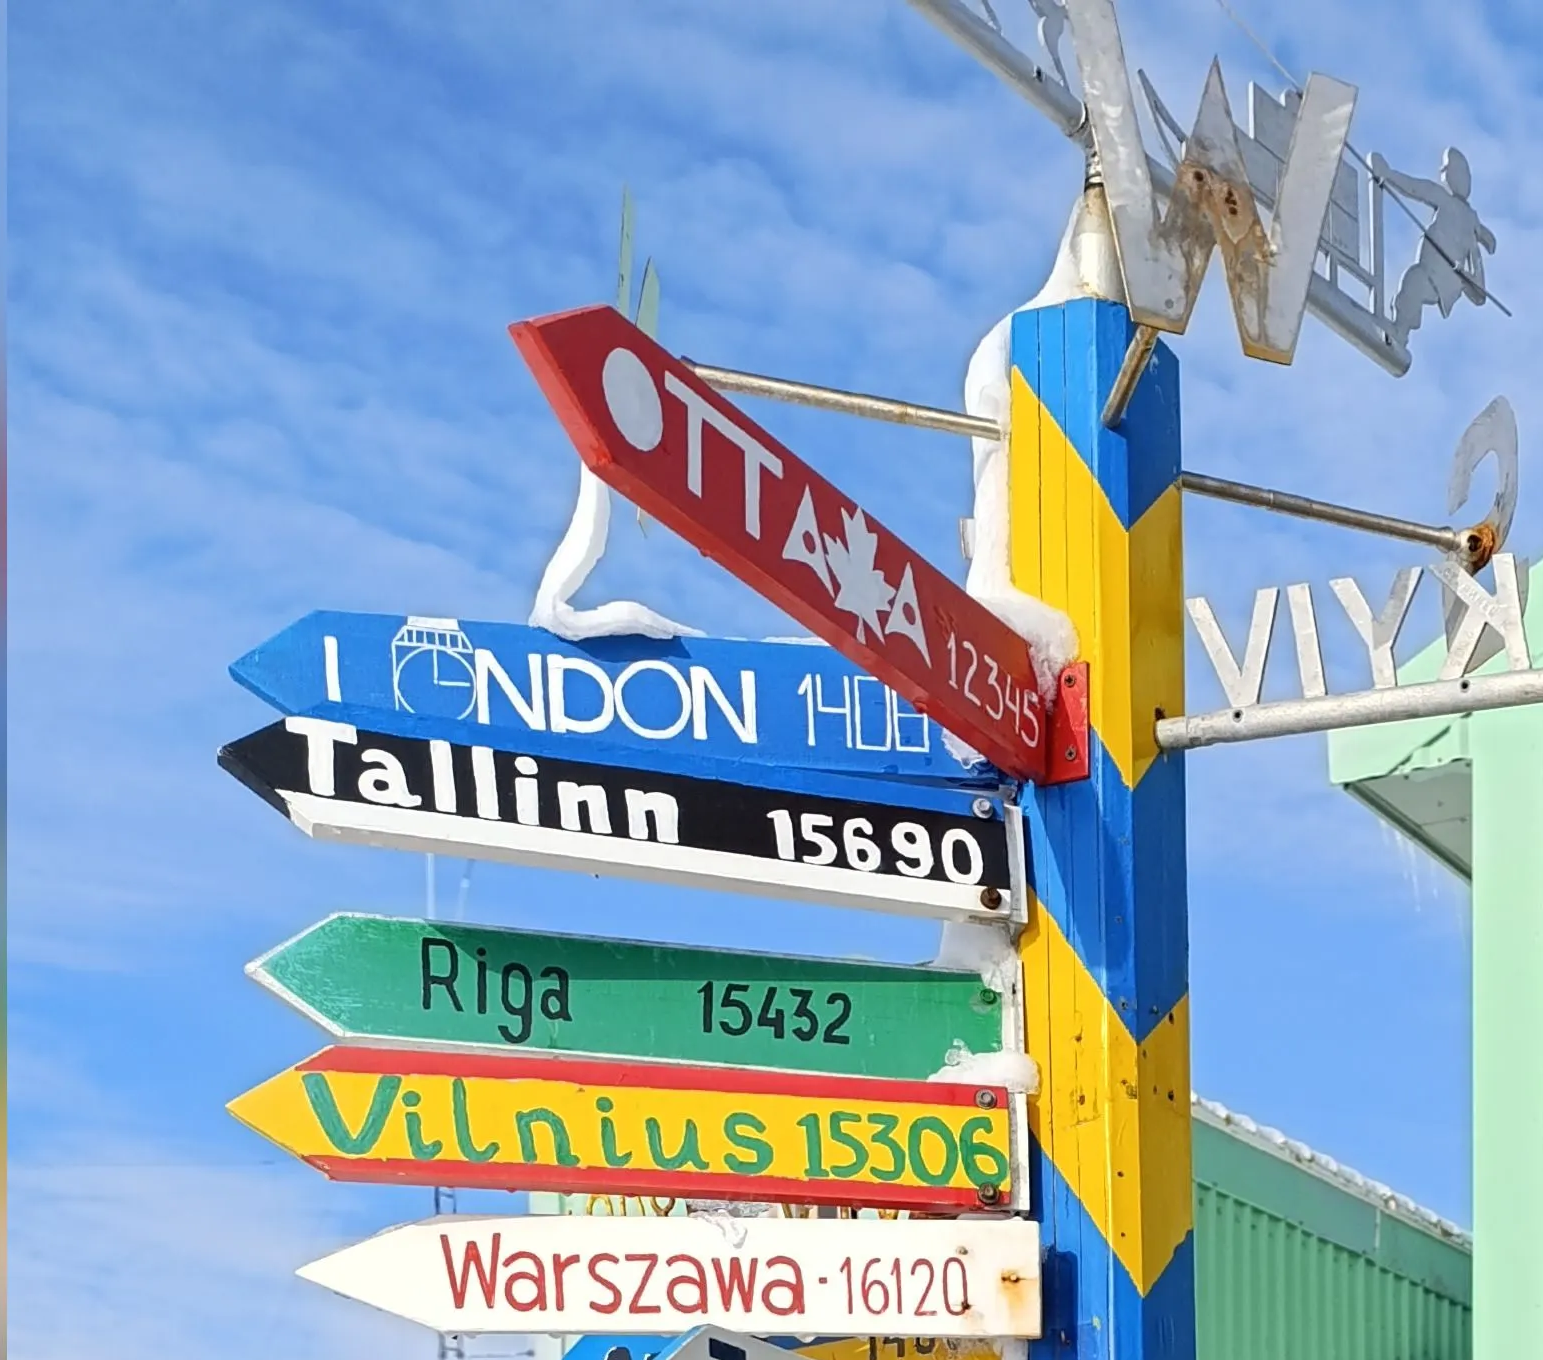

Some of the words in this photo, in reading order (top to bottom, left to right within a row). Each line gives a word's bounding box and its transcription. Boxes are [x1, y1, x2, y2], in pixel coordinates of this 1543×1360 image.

[947, 632, 1041, 748] 12345
[284, 716, 680, 846] Tallinn
[766, 809, 985, 885] 15690
[420, 937, 572, 1044] Riga
[698, 980, 853, 1046] 15432
[301, 1074, 775, 1176] Vilnius
[797, 1112, 1010, 1192] 15306
[440, 1233, 807, 1318] Warszawa
[840, 1256, 970, 1318] 16120
